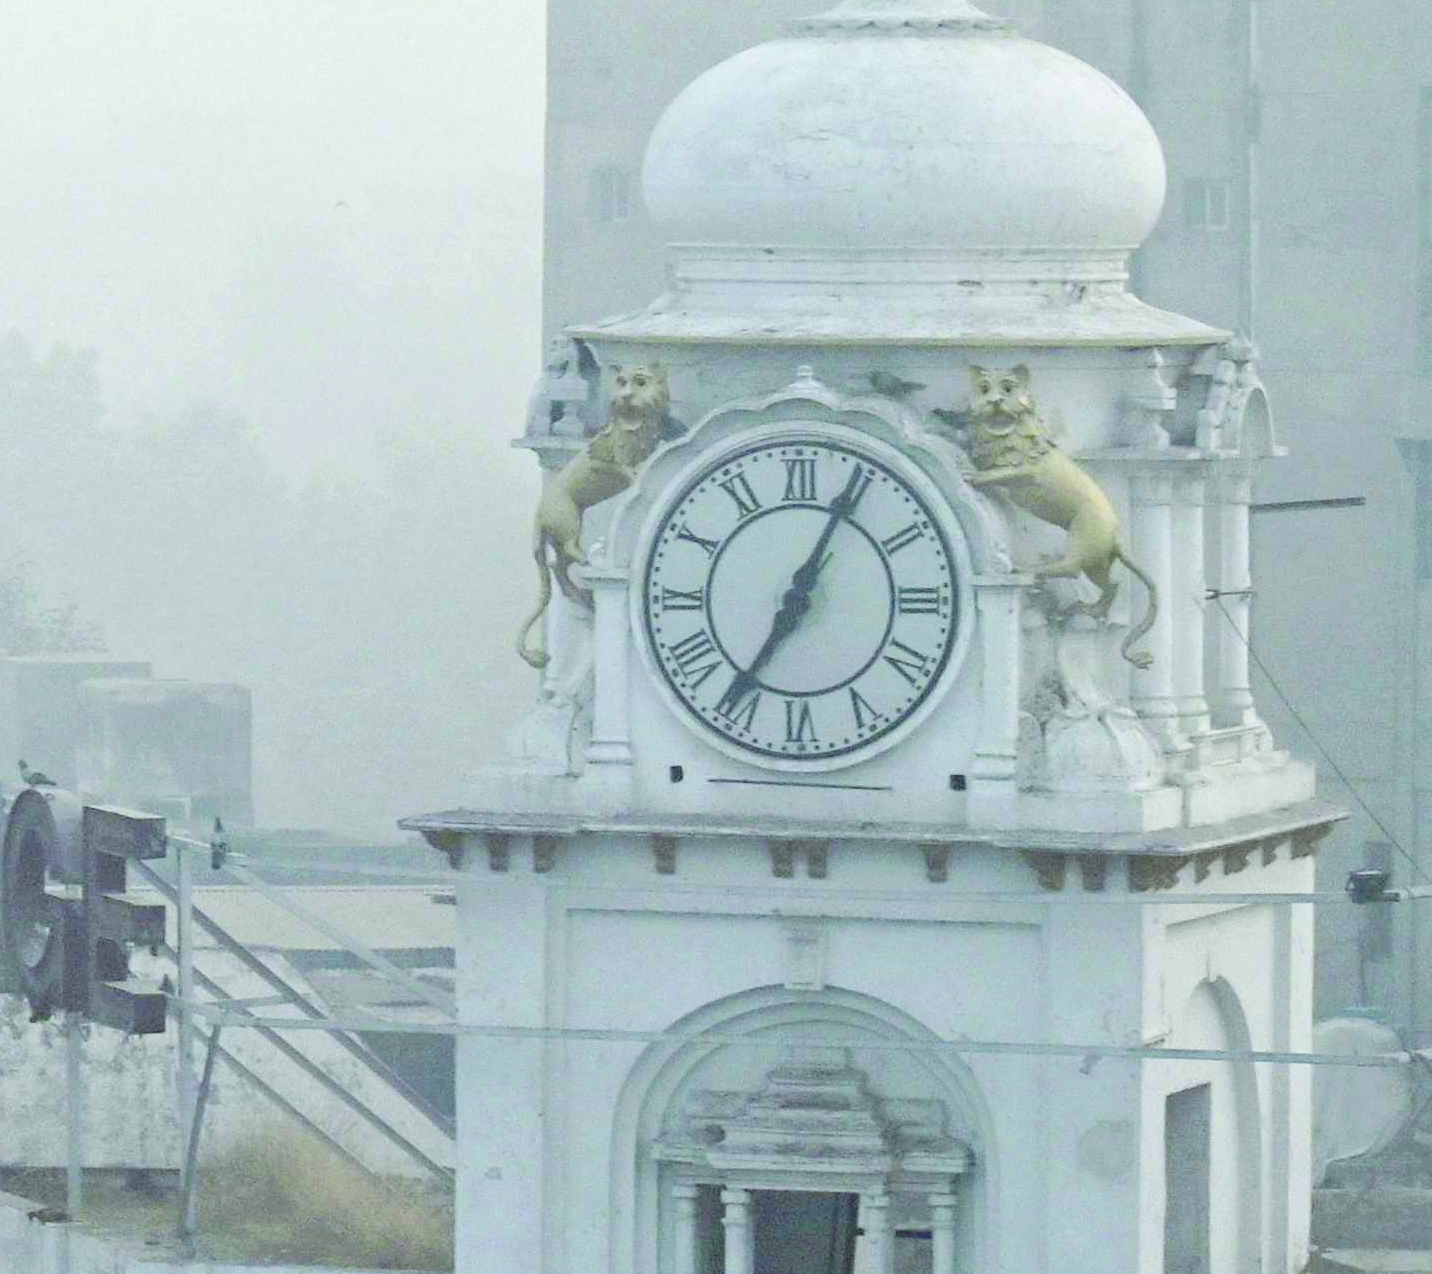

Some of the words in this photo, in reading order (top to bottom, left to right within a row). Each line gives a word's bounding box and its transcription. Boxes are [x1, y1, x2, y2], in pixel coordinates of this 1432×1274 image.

[719, 471, 763, 521] XI
[781, 458, 817, 501] XII
[675, 524, 721, 558] X
[881, 523, 925, 556] II
[662, 587, 703, 610] IX
[898, 586, 940, 615] III
[669, 629, 723, 691] VIII
[883, 637, 936, 687] IV
[784, 700, 821, 743] VI
[849, 687, 884, 729] V
